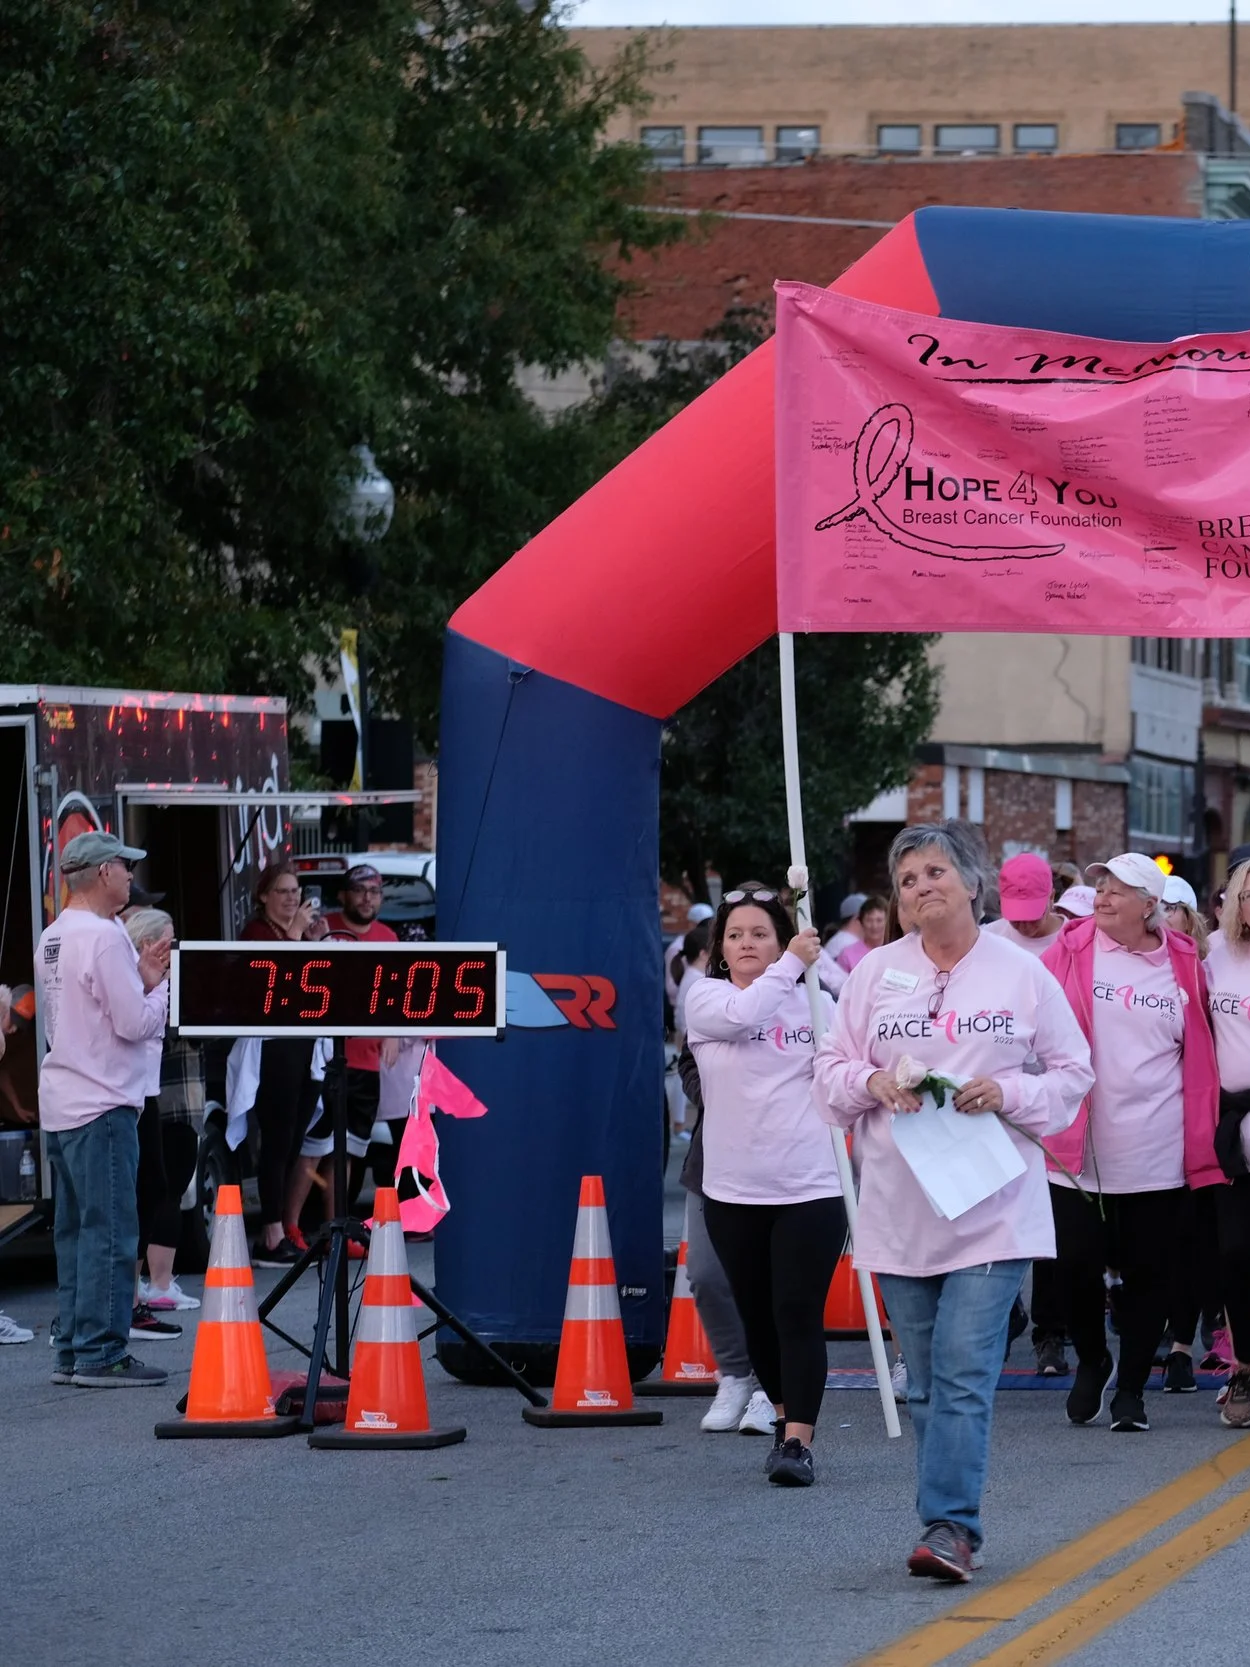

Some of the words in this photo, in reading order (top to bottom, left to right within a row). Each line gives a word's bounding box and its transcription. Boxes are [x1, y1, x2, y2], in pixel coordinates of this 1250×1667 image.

[907, 333, 988, 370] In
[905, 466, 1002, 502] HOPE
[1009, 470, 1038, 505] 4
[1046, 477, 1118, 509] YOU
[903, 509, 957, 525] Breast
[964, 509, 1024, 525] Cancer
[1030, 511, 1122, 528] Foundation
[531, 973, 617, 1030] RR
[1093, 986, 1115, 1001] CE
[1133, 994, 1177, 1016] HOPE
[1208, 998, 1240, 1015] ACE
[878, 1020, 933, 1042] RACE
[958, 1016, 1015, 1035] HOPE
